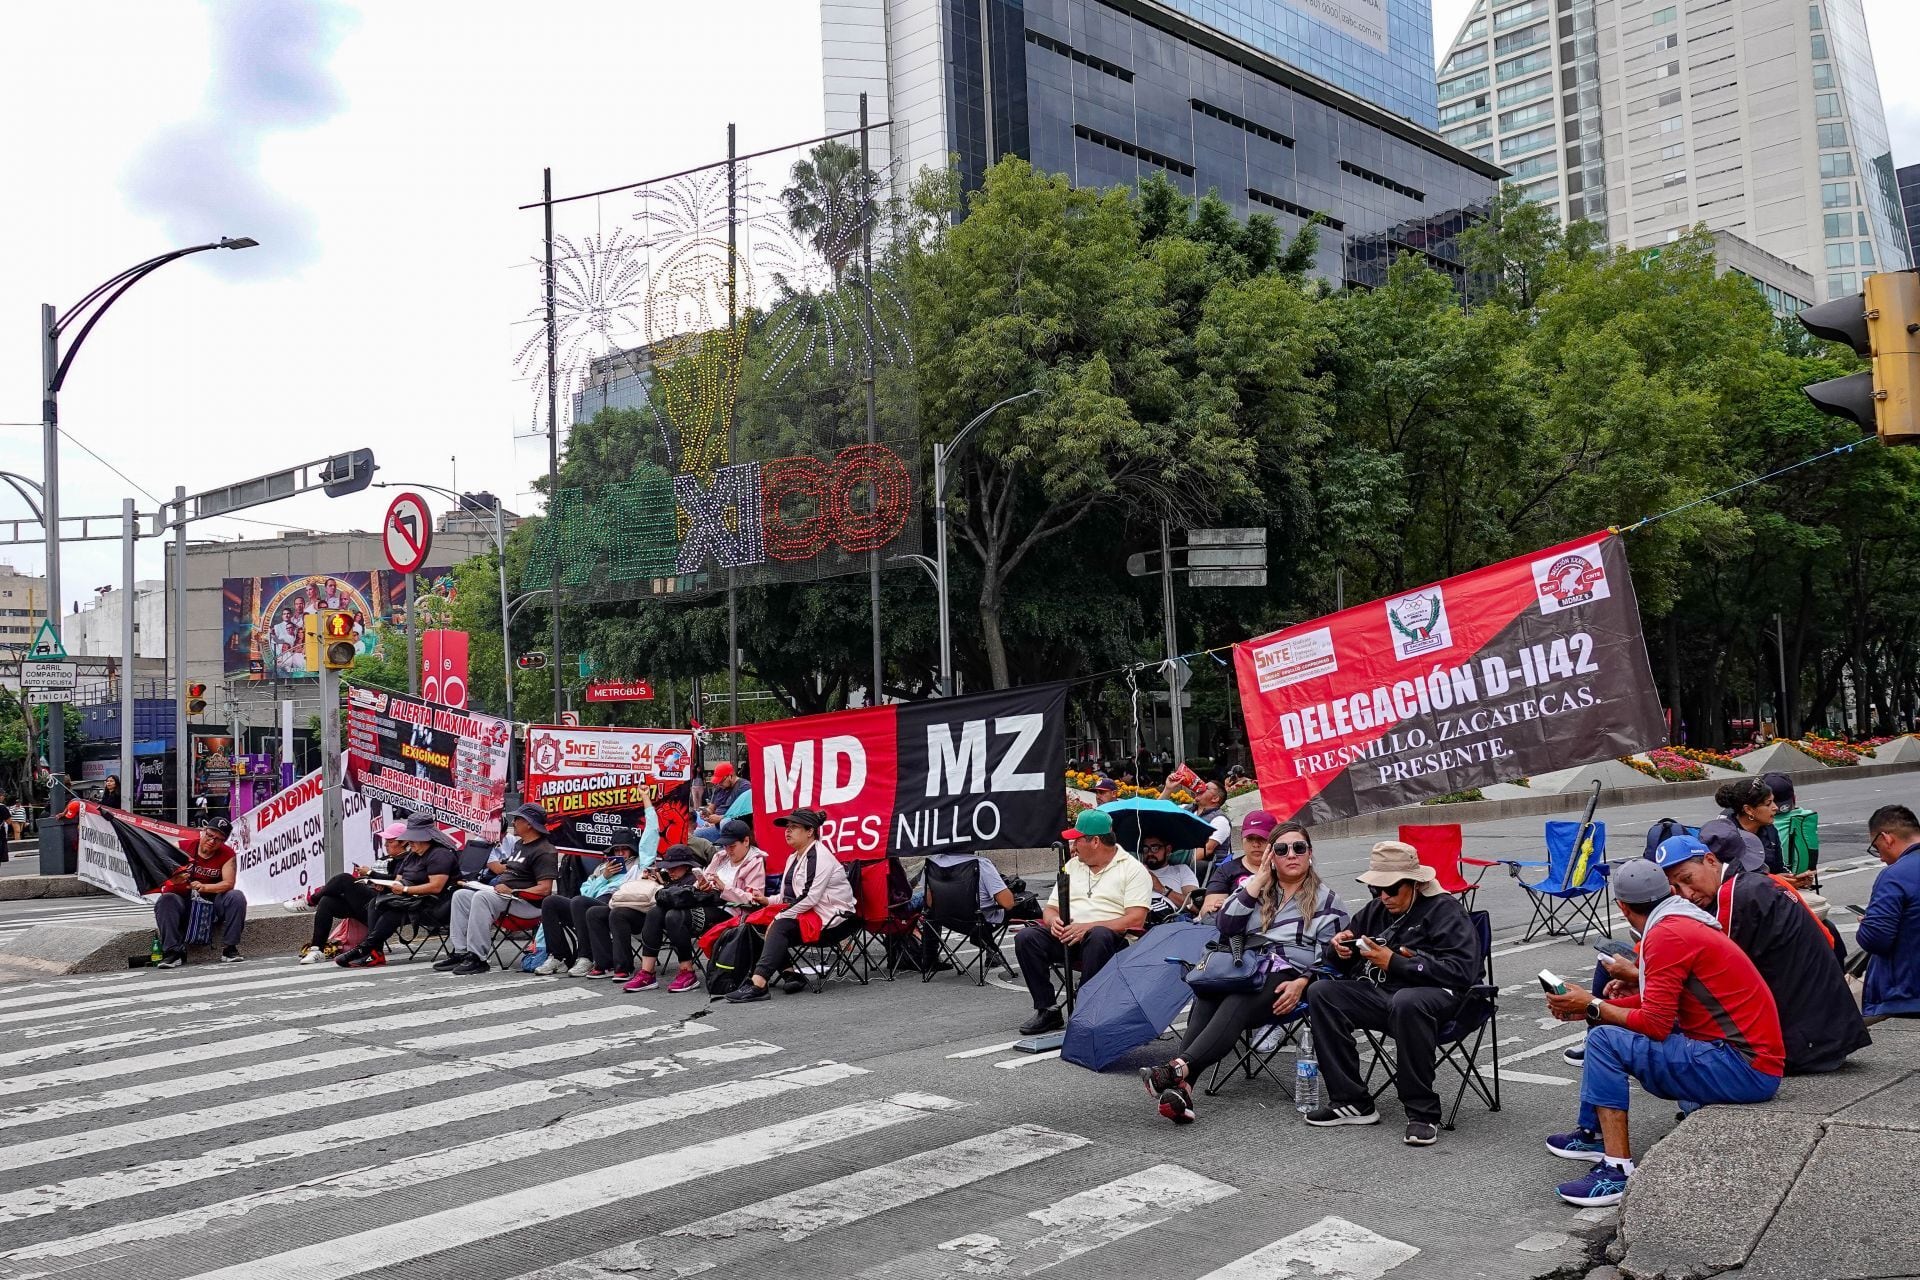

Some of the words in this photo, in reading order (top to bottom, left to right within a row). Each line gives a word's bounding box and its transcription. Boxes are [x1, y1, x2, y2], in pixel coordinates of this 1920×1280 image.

[1561, 595, 1584, 606] MDMZ
[1254, 647, 1291, 669] SNTE
[594, 687, 646, 697] METROBUS
[389, 698, 433, 727] ¡ALERTA
[433, 708, 483, 740] MÁXIMA!
[1280, 663, 1478, 750] DELEGACIÓN
[1294, 728, 1434, 777] FRESNILLO,
[1437, 686, 1602, 741] ZACATECAS.
[402, 743, 450, 768] ¡EXIGIMOS!
[565, 740, 597, 756] SNTE
[631, 743, 651, 763] 34
[763, 735, 867, 814] MD
[925, 712, 1046, 797] MZ
[1378, 737, 1514, 785] PRESENTE.
[620, 774, 632, 786] DE
[256, 773, 323, 832] ¡EXIGIMO
[446, 799, 471, 818] ISSSTE
[471, 807, 491, 824] 2007
[541, 796, 561, 813] LEY
[563, 793, 586, 811] DEL
[588, 788, 628, 808] ISSSTE
[435, 809, 483, 834] VENCEREMOS!
[609, 814, 622, 825] 92
[240, 851, 263, 872] MESA
[263, 825, 302, 862] NACIONAL
[303, 814, 322, 839] CON
[585, 833, 613, 846] FRESN
[269, 848, 307, 878] CLAUDIA
